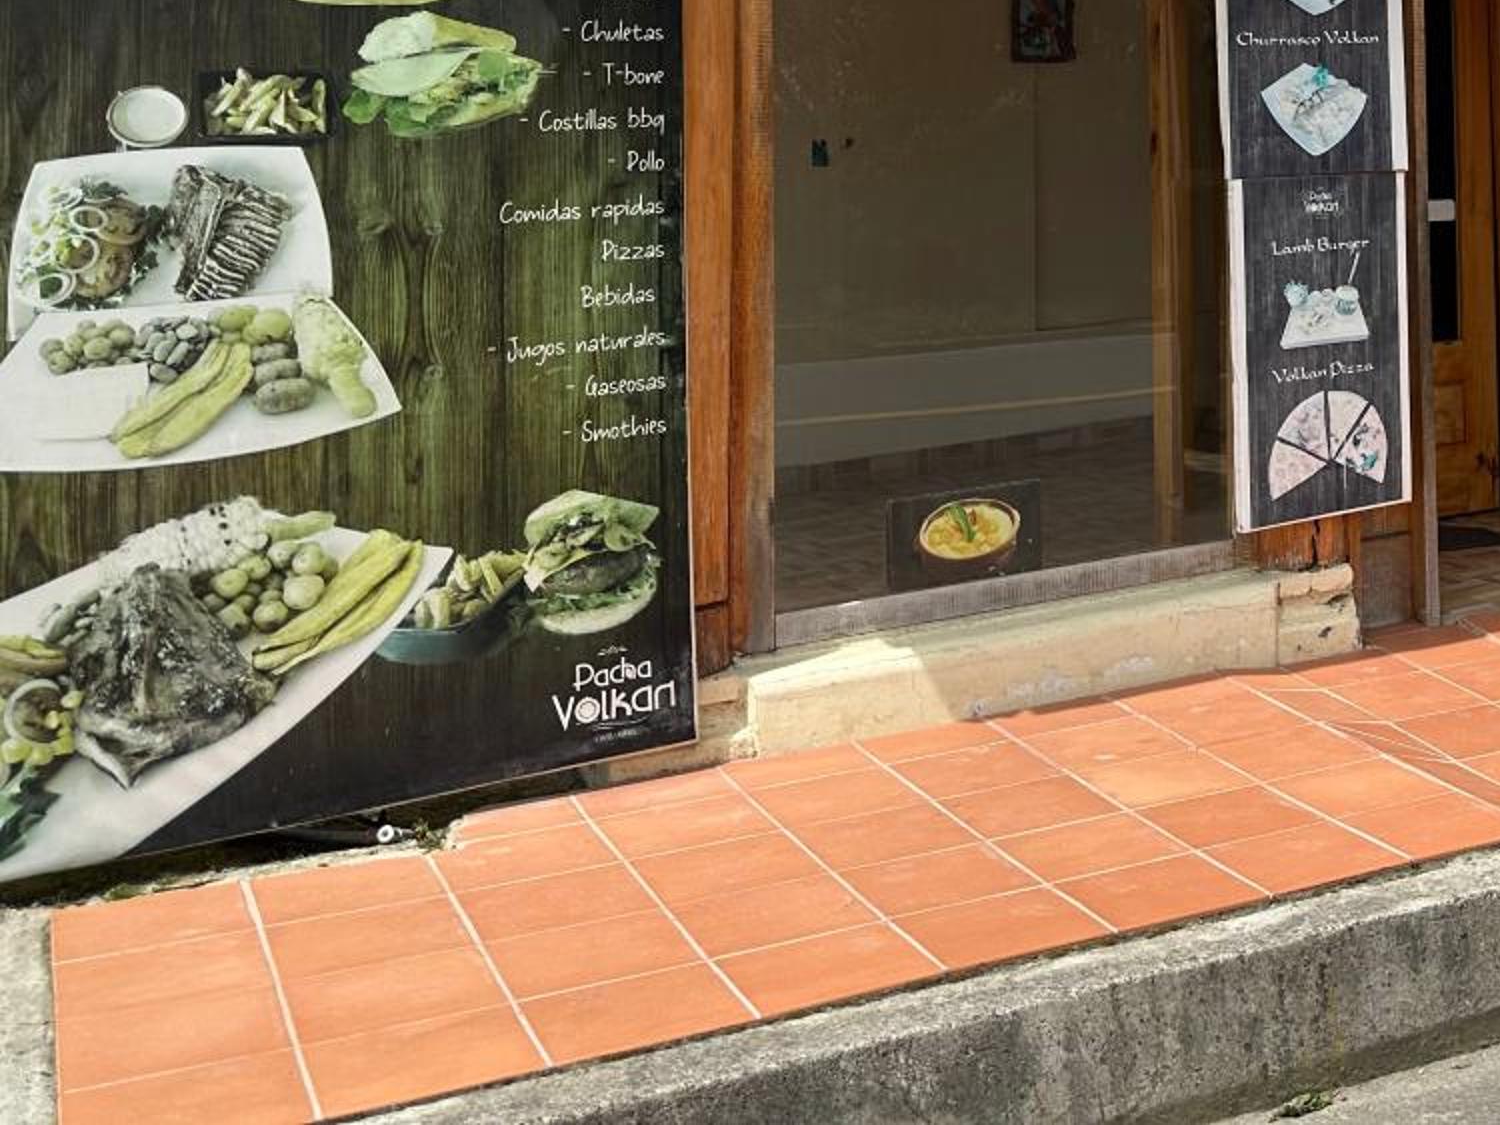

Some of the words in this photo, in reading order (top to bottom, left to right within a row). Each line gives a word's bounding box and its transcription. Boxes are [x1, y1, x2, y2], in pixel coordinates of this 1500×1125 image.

[581, 20, 665, 43] Chuletas
[1236, 31, 1321, 48] Churrasco
[1324, 29, 1381, 46] Volkan
[602, 61, 665, 86] T-bone
[539, 108, 617, 133] Costillas
[627, 106, 665, 135] bbq
[626, 149, 665, 173] Pollo
[499, 198, 581, 225] Comidas
[591, 193, 665, 225] rapidas
[602, 238, 665, 262] Pizzas
[1271, 238, 1315, 256] Lamb
[580, 283, 656, 308] Bebidas
[507, 335, 566, 366] Jugos
[575, 325, 666, 354] naturales
[1271, 366, 1328, 383] Volkan
[1330, 359, 1375, 378] Pizza
[585, 373, 666, 397] Gaseosas
[581, 415, 667, 443] Smothies
[573, 657, 653, 692] Pacha
[552, 680, 677, 731] Volkan
